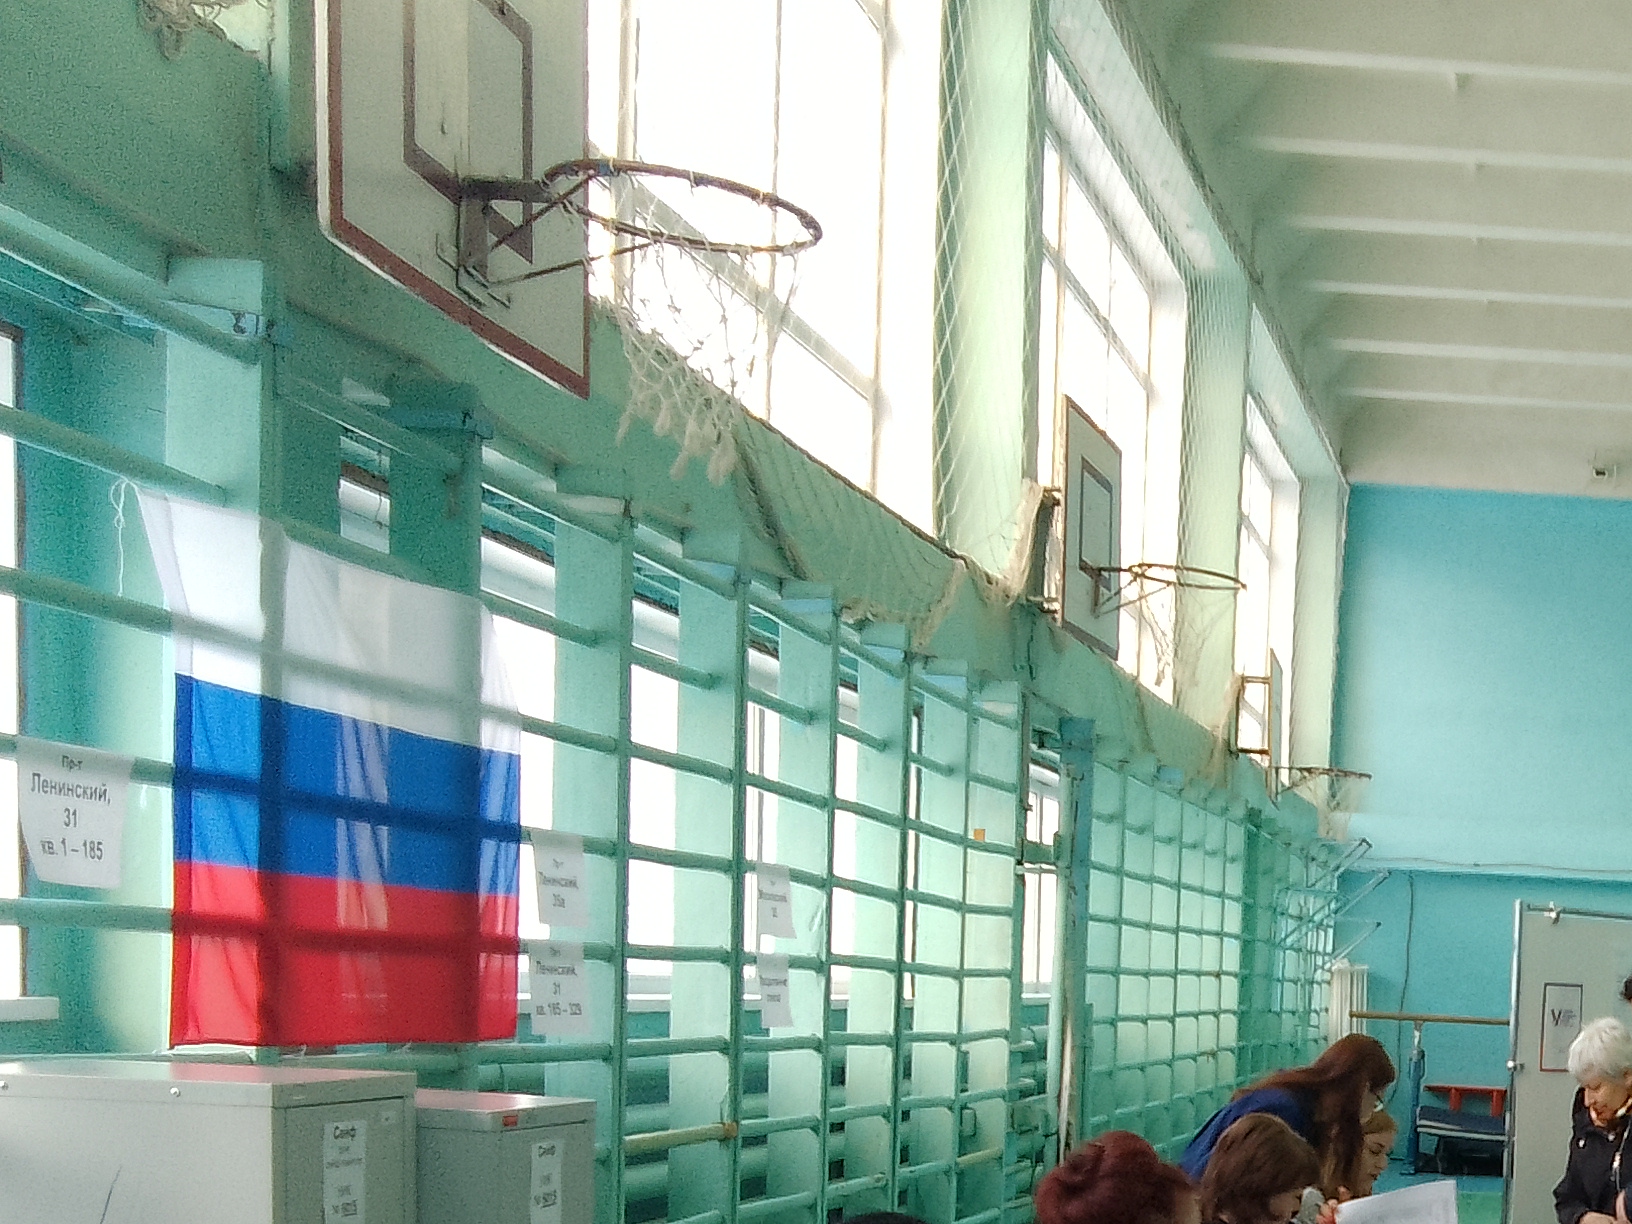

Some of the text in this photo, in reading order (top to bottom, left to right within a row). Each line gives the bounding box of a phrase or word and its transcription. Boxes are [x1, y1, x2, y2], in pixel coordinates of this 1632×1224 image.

[61, 754, 83, 772] Пр-т
[31, 772, 111, 806] Ленинский,
[63, 807, 78, 828] 31
[60, 837, 67, 857] 1
[82, 839, 103, 861] 185
